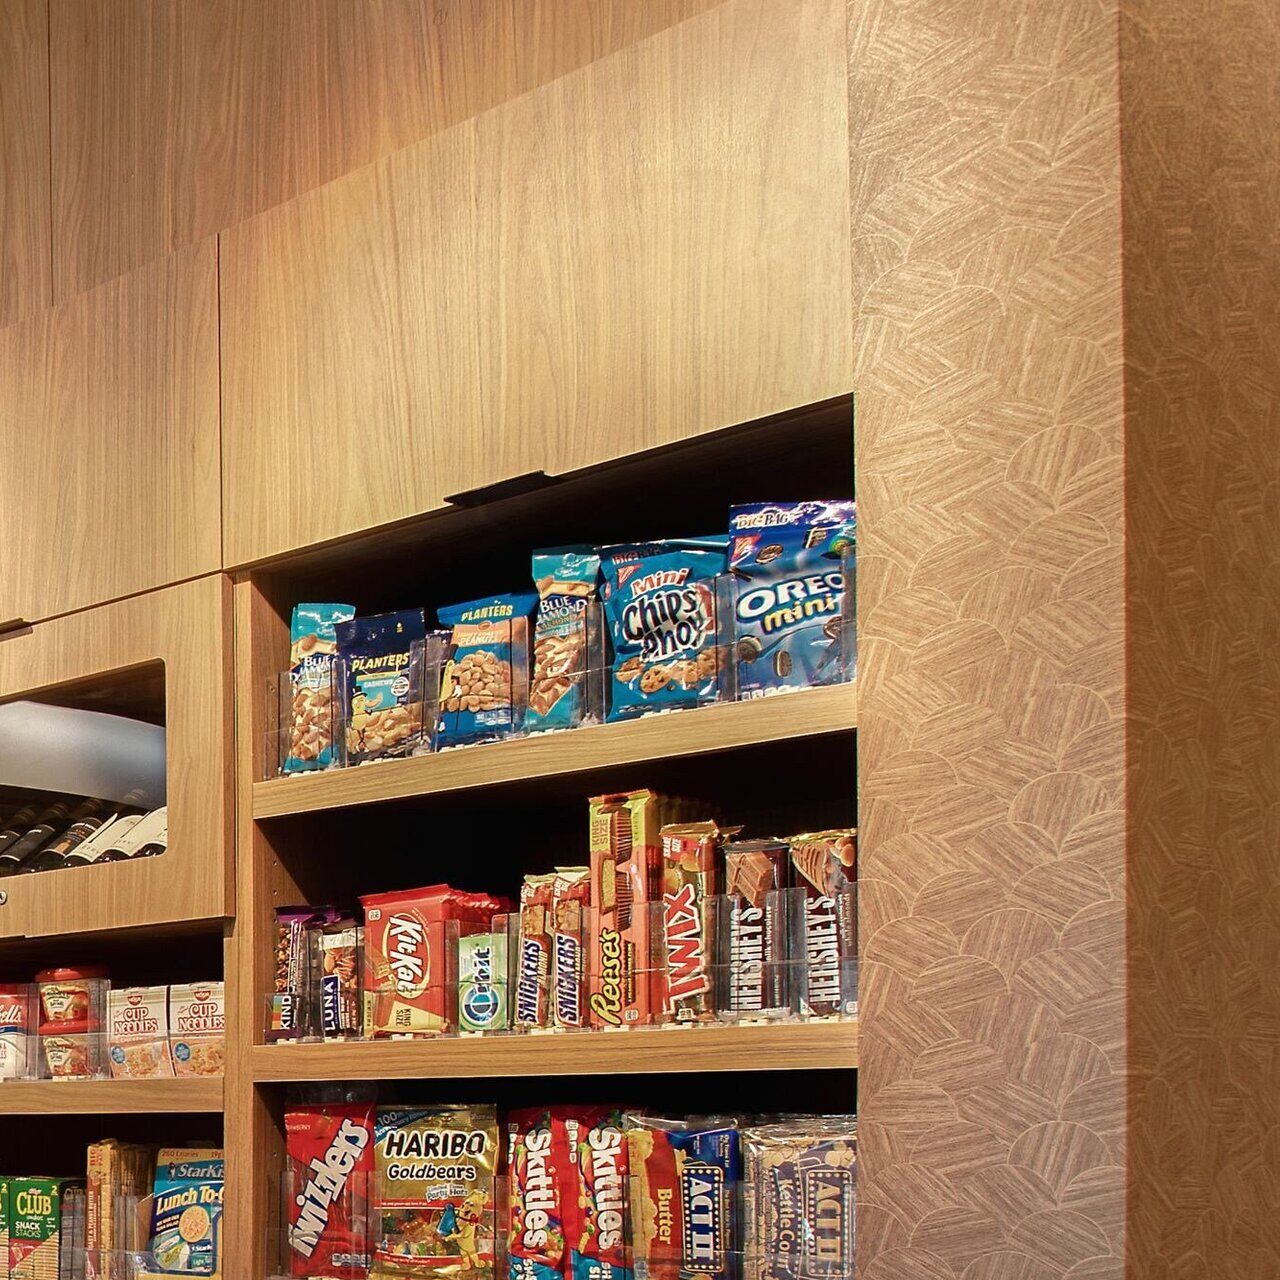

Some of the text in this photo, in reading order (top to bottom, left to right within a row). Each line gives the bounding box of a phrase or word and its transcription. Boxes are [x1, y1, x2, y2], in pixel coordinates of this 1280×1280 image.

[630, 567, 690, 599] Mini
[736, 572, 846, 621] OREO
[461, 604, 514, 622] PLANTERS
[539, 595, 572, 614] BLUE
[622, 585, 698, 644] Chips
[352, 652, 410, 673] PLANTERS
[592, 819, 600, 846] KING
[599, 818, 609, 845] SIZE
[662, 884, 709, 1013] TWIX
[730, 907, 764, 1011] HERSHEY'S
[803, 895, 841, 1004] HERSHEY'S
[517, 937, 542, 1024] SNICKERS
[556, 934, 578, 1024] SNICKERS
[590, 928, 622, 1025] Reese's
[123, 1007, 149, 1021] CUP
[189, 1003, 218, 1017] CUP
[280, 994, 292, 1030] KIND
[324, 981, 336, 1032] LUNA
[395, 1009, 403, 1027] SIZE
[404, 1008, 412, 1027] KING
[113, 1020, 159, 1035] NOODLES
[177, 1016, 225, 1032] NOODLES
[384, 1130, 487, 1159] HARIBO
[178, 1163, 224, 1179] StarKis
[387, 1163, 477, 1181] Goldbears
[427, 1190, 448, 1202] Party
[523, 1128, 555, 1250] Skittles
[589, 1126, 624, 1251] Skittles
[16, 1192, 52, 1215] CLUB
[156, 1192, 198, 1216] Lunch
[656, 1188, 674, 1246] Butter
[15, 1221, 40, 1230] SNACK
[688, 1177, 714, 1261] ACT II
[776, 1178, 794, 1270] Kettle Corn
[815, 1180, 842, 1264] ACT II
[15, 1229, 41, 1238] STACKS
